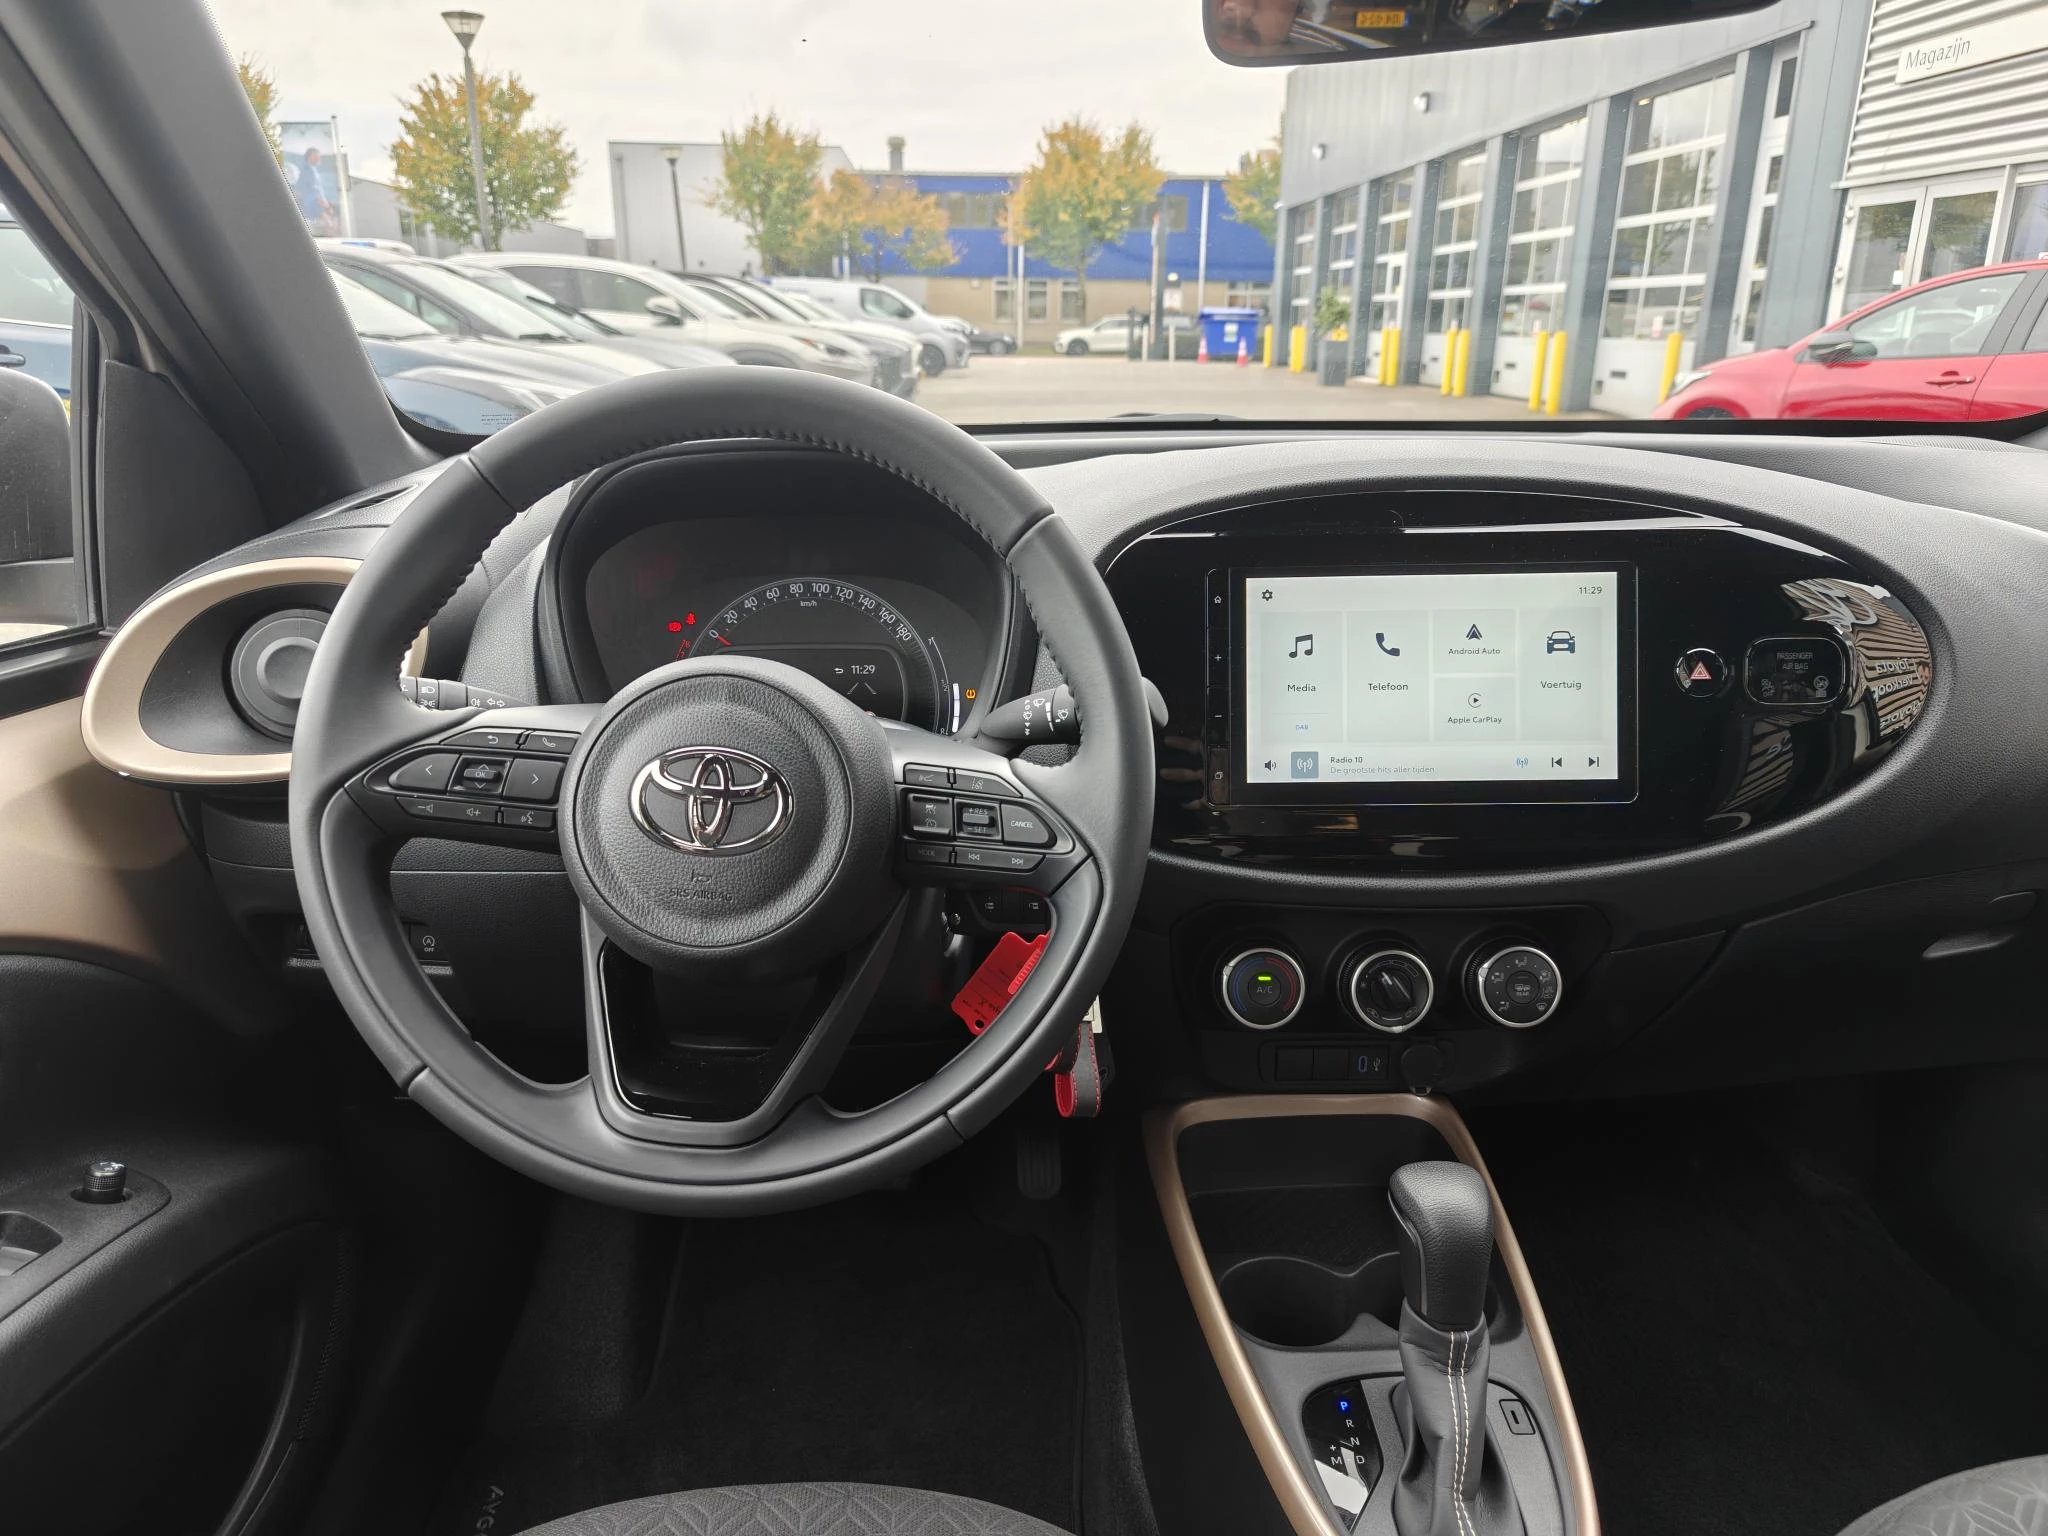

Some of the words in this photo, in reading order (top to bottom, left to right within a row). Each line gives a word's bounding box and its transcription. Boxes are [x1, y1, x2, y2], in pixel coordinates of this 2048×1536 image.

[1905, 37, 1971, 71] Magazijn
[790, 583, 804, 594] 80
[812, 583, 830, 593] 100
[836, 586, 853, 600] 120
[1579, 586, 1602, 595] 11:29
[766, 587, 780, 600] 60
[744, 596, 758, 609] 40
[858, 594, 876, 609] 140
[723, 609, 738, 624] 20
[878, 607, 896, 624] 160
[708, 629, 719, 639] 0
[895, 623, 912, 641] 180
[1482, 647, 1501, 655] Auto
[850, 664, 876, 675] 11:29
[1287, 684, 1317, 692] Media
[1368, 682, 1409, 691] Telefoon
[1540, 680, 1582, 690] Voertuig
[1447, 716, 1471, 724] Apple
[1472, 715, 1502, 724] CarPlay
[1330, 756, 1353, 764] Radio
[1330, 766, 1342, 774] De
[1343, 766, 1376, 775] grootste
[1377, 766, 1392, 774] hits
[1393, 765, 1411, 773] aller
[1412, 764, 1435, 774] tijden
[1256, 985, 1273, 994] A/C
[1340, 1401, 1348, 1411] P
[1350, 1436, 1360, 1446] N
[1331, 1457, 1342, 1465] M
[1355, 1455, 1365, 1465] D
[472, 1485, 504, 1536] AYG
